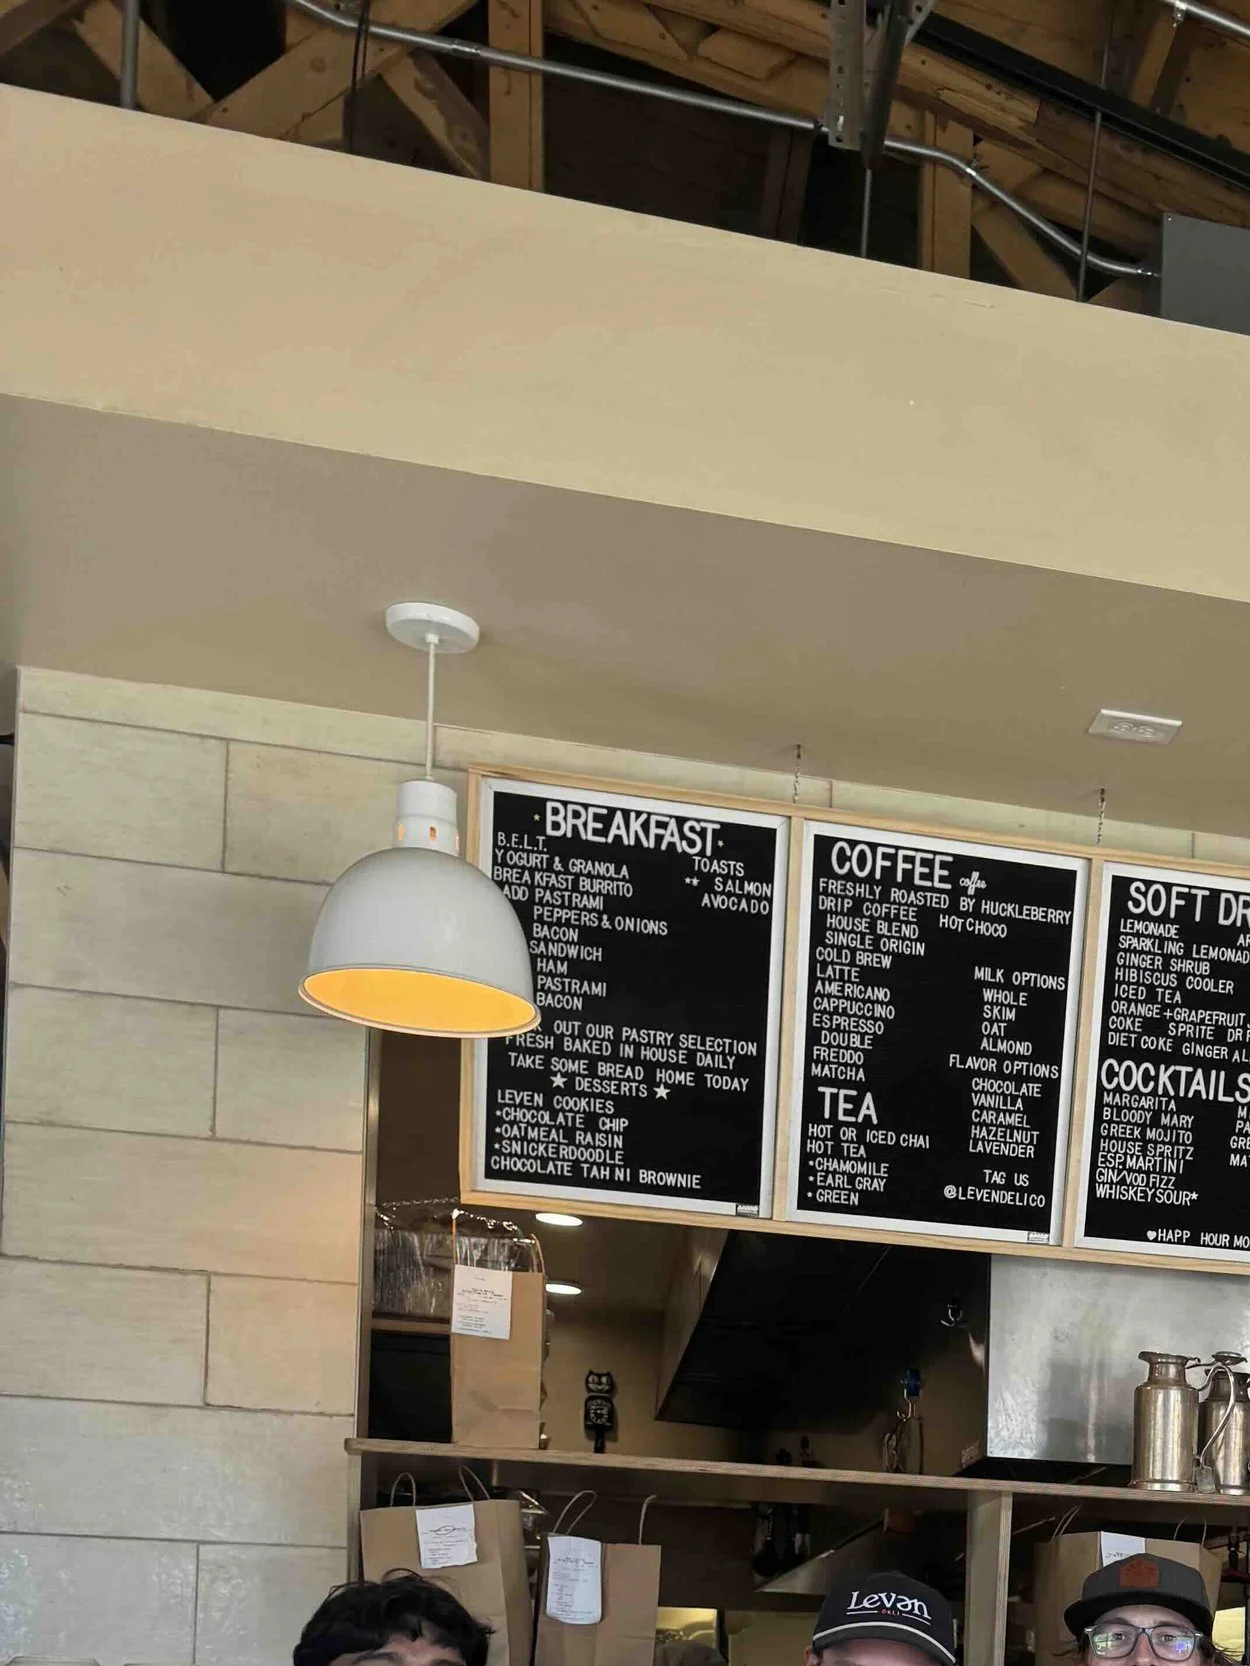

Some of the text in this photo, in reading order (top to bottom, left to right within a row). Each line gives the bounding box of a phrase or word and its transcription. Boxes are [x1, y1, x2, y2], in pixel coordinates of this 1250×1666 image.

[544, 802, 720, 856] BREAKFAST
[692, 856, 744, 876] TOASTS
[832, 841, 986, 895] COFFEE coffee
[494, 866, 632, 897] BREAKFAST BURRITO
[715, 877, 771, 897] SALMON
[503, 886, 603, 910] ADD PASTRAMI
[702, 893, 769, 914] AVOCADO
[819, 896, 917, 921] DRIP COFFEE
[820, 878, 1071, 924] FRESHLY ROASTED BY HUCKLEBERRY
[1128, 882, 1209, 922] SOFT
[534, 923, 578, 942] BACON
[827, 914, 918, 938] HOUSE BLEND
[1120, 919, 1179, 938] LEMONADE
[530, 940, 602, 961] SANDWICH
[826, 931, 924, 956] SINGLE ORIGIN
[1119, 936, 1184, 955] SPARKLING
[538, 958, 567, 974] HAM
[816, 947, 892, 968] COLD BREW
[1117, 952, 1210, 975] GINGER SHRUB
[817, 964, 859, 981] LATTE
[975, 966, 1065, 990] MILK OPTIONS
[1115, 967, 1234, 994] HIBISCUS COOLER
[538, 976, 606, 996] PASTRAMI
[815, 980, 890, 1002] AMERICANO
[1115, 984, 1181, 1004] ICED TEA
[537, 992, 582, 1010] BACON
[983, 988, 1027, 1006] WHOLE
[814, 997, 894, 1019] CAPPUCCINO
[984, 1005, 1015, 1021] SKIM
[813, 1013, 884, 1034] ESPRESSO
[982, 1022, 1007, 1036] OAT
[1109, 1016, 1142, 1031] COKE
[1168, 1022, 1214, 1039] SPRITE
[1228, 1028, 1242, 1042] DR
[554, 1020, 581, 1035] OUT
[586, 1024, 613, 1039] OUR
[622, 1027, 674, 1046] PASTRY
[679, 1034, 756, 1056] SELECTION
[822, 1030, 873, 1048] DOUBLE
[981, 1037, 1032, 1055] ALMOND
[814, 1046, 863, 1064] FREDDO
[812, 1063, 865, 1081] MATCHA
[950, 1054, 1058, 1078] FLAVOR OPTIONS
[576, 1077, 647, 1097] DESSERTS
[972, 1078, 1042, 1096] CHOCOLATE
[498, 1090, 614, 1114] LEVEN COOKIES
[818, 1087, 877, 1124] TEA
[972, 1093, 1023, 1110] VANILLA
[1104, 1092, 1176, 1111] MARGARITA
[503, 1107, 628, 1132] CHOCOLATE CHIP
[972, 1110, 1030, 1128] CARAMEL
[1103, 1107, 1194, 1128] BLOODY MARY
[502, 1124, 622, 1148] OATMEAL RAISIN
[972, 1125, 1039, 1144] HAZELNUT
[1101, 1123, 1192, 1144] GREEK MOJITO
[502, 1140, 623, 1164] SNICKERDOODLE
[970, 1140, 1034, 1158] LAVENDER
[1100, 1139, 1194, 1160] HOUSE SPRITZ
[816, 1158, 888, 1176] CHAMOMILE
[817, 1172, 886, 1191] EARL GRAY
[816, 1189, 858, 1205] GREEN
